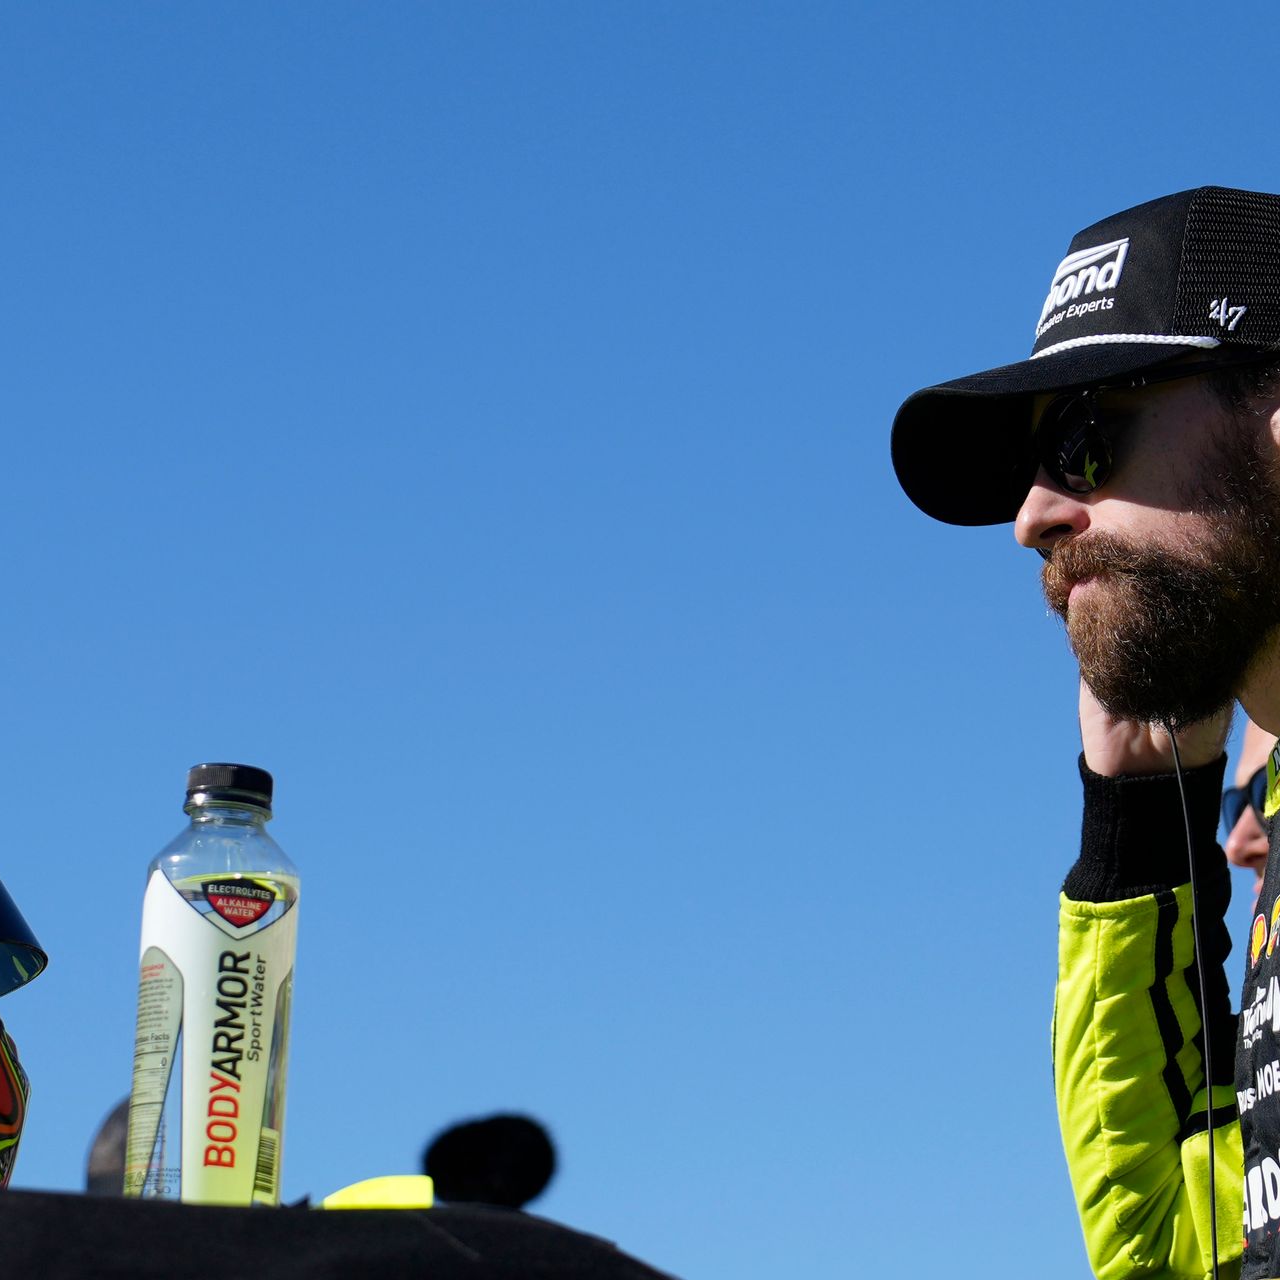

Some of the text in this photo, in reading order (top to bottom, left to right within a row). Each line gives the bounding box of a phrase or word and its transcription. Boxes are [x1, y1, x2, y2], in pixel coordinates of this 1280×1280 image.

[1066, 297, 1115, 318] Experts
[208, 884, 271, 899] ELECTROLYTES
[217, 898, 262, 910] ALKALINE
[224, 906, 255, 918] WATER
[247, 954, 267, 1062] SportWater
[203, 950, 251, 1168] BODYARMOR
